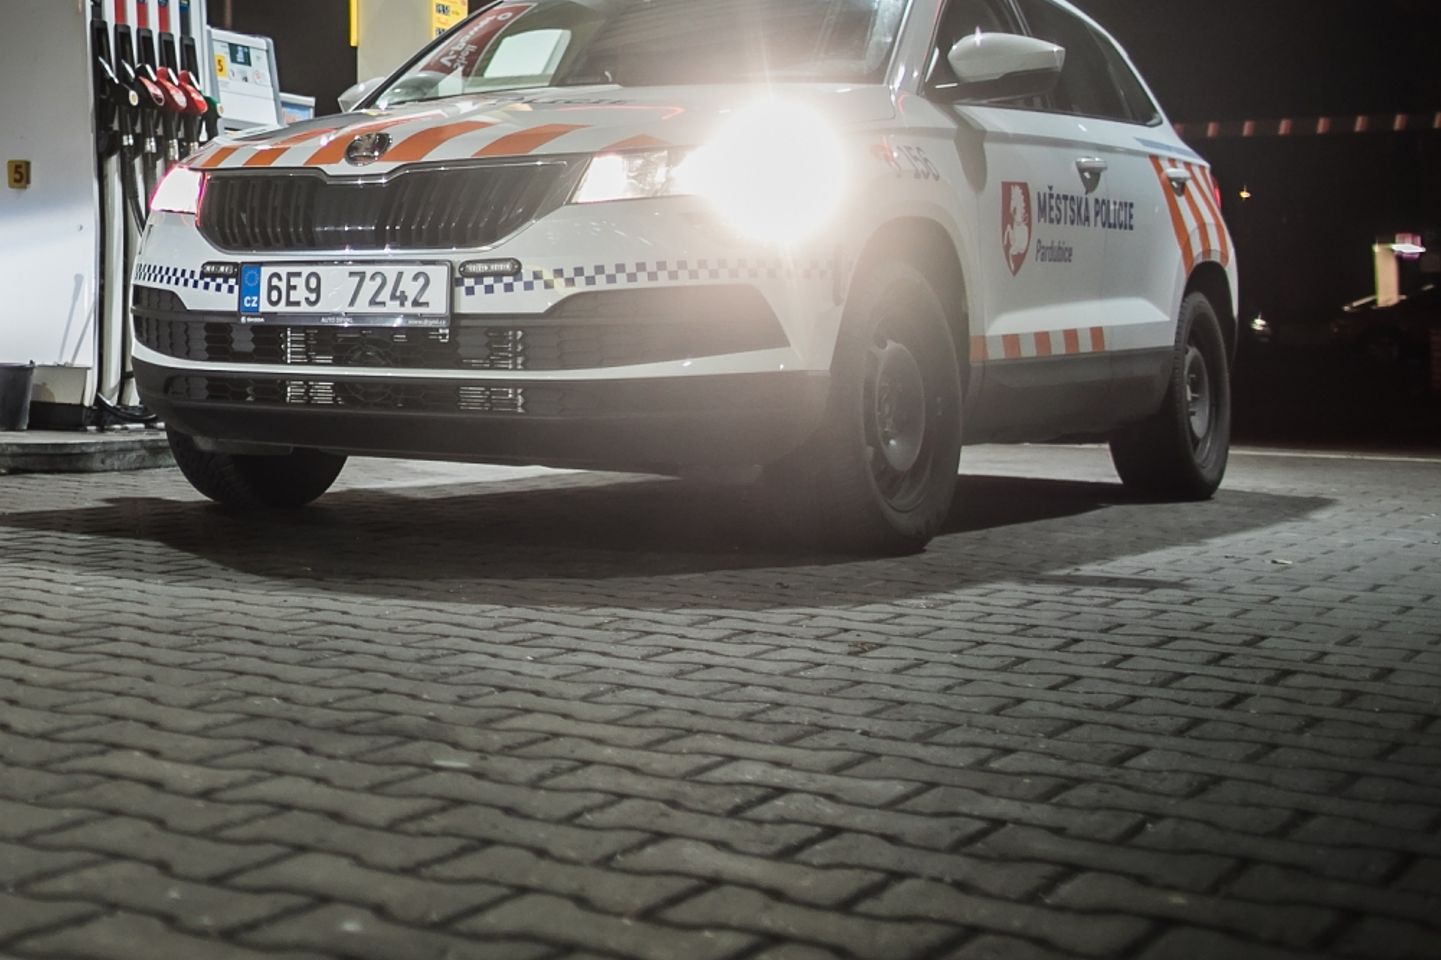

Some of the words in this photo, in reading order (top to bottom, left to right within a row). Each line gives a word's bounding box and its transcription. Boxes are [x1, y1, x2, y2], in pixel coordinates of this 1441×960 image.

[14, 164, 24, 183] 5
[1037, 185, 1091, 225] MĚSTSKÁ
[1094, 197, 1135, 231] POLICIE
[1035, 236, 1074, 263] Pardubice
[244, 296, 258, 308] CZ
[267, 271, 322, 307] 6E9
[347, 271, 431, 308] 7242
